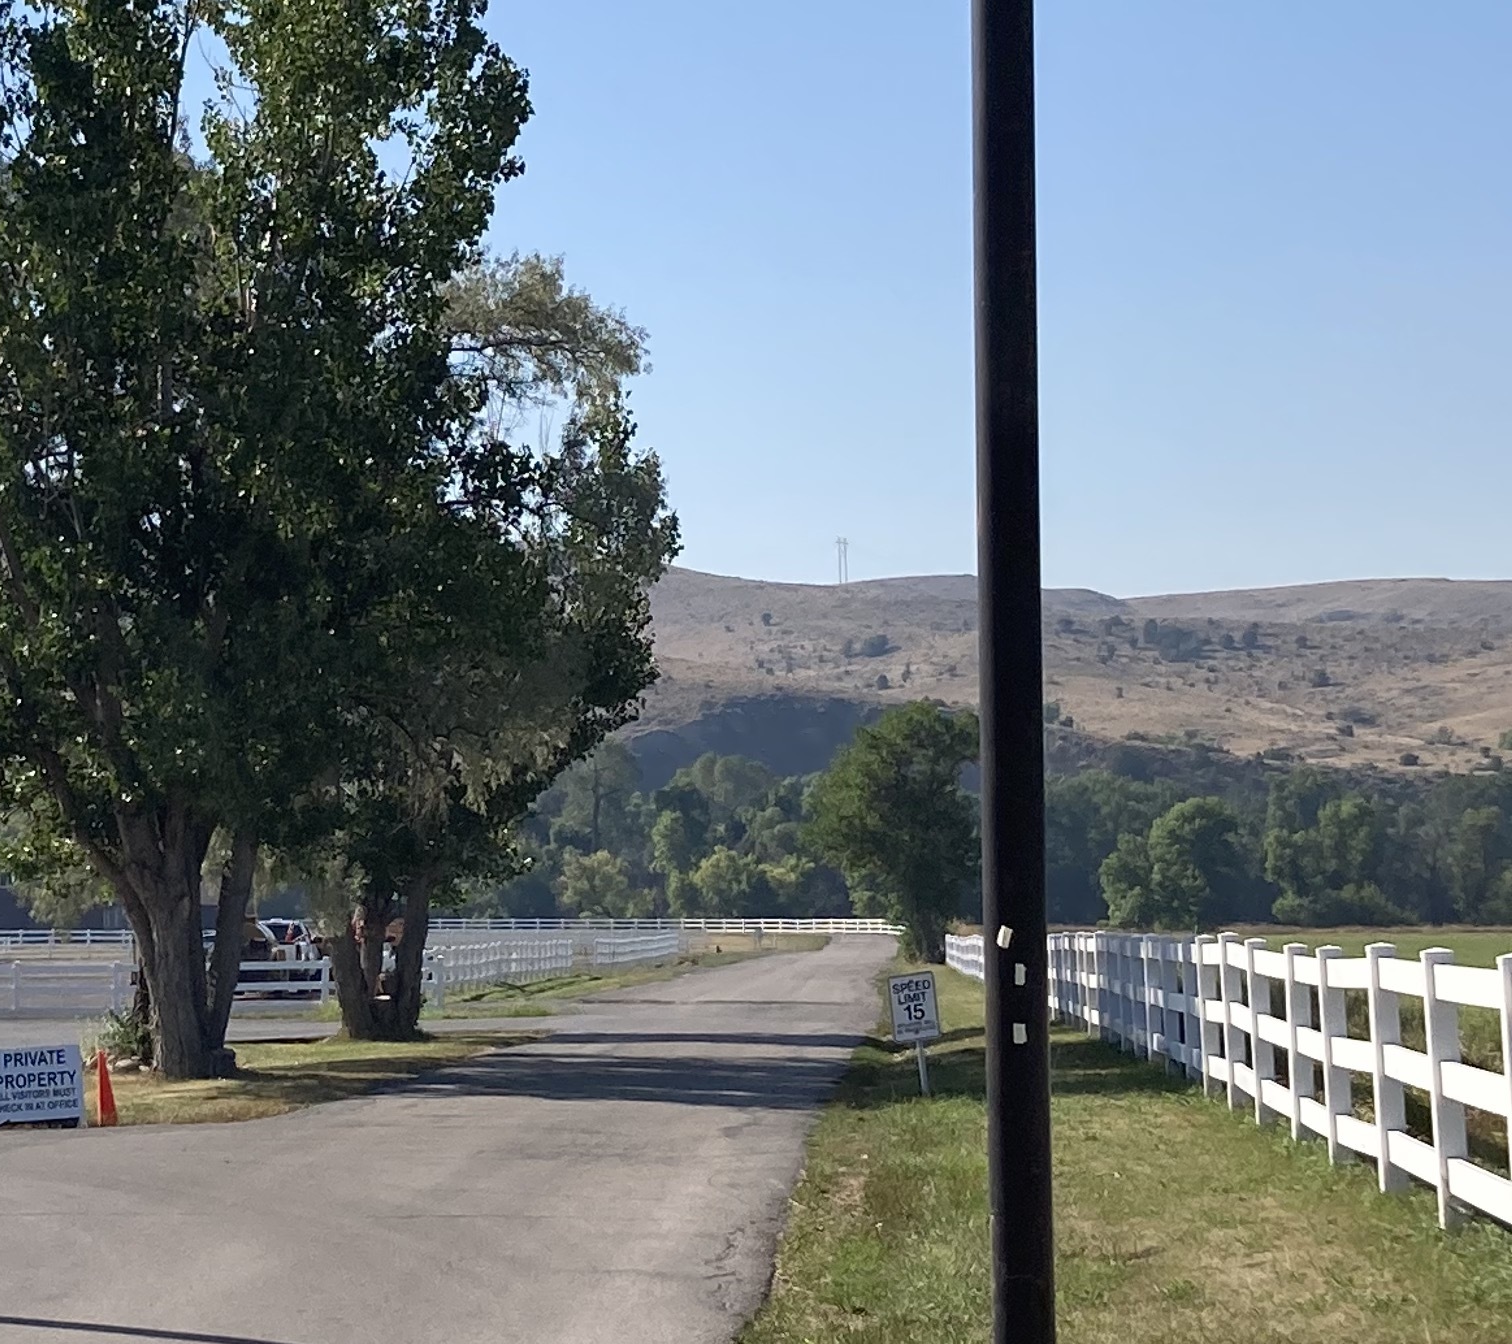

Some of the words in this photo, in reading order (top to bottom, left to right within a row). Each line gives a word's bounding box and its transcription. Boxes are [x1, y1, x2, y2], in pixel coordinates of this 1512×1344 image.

[892, 979, 931, 994] SPEED
[897, 992, 927, 1005] LIMIT
[903, 1003, 925, 1021] 15
[3, 1049, 66, 1068] PRIVATE
[11, 1089, 50, 1101] VISITORS
[53, 1087, 76, 1097] MUST
[24, 1102, 34, 1111] IN
[48, 1099, 78, 1110] OFFICE
